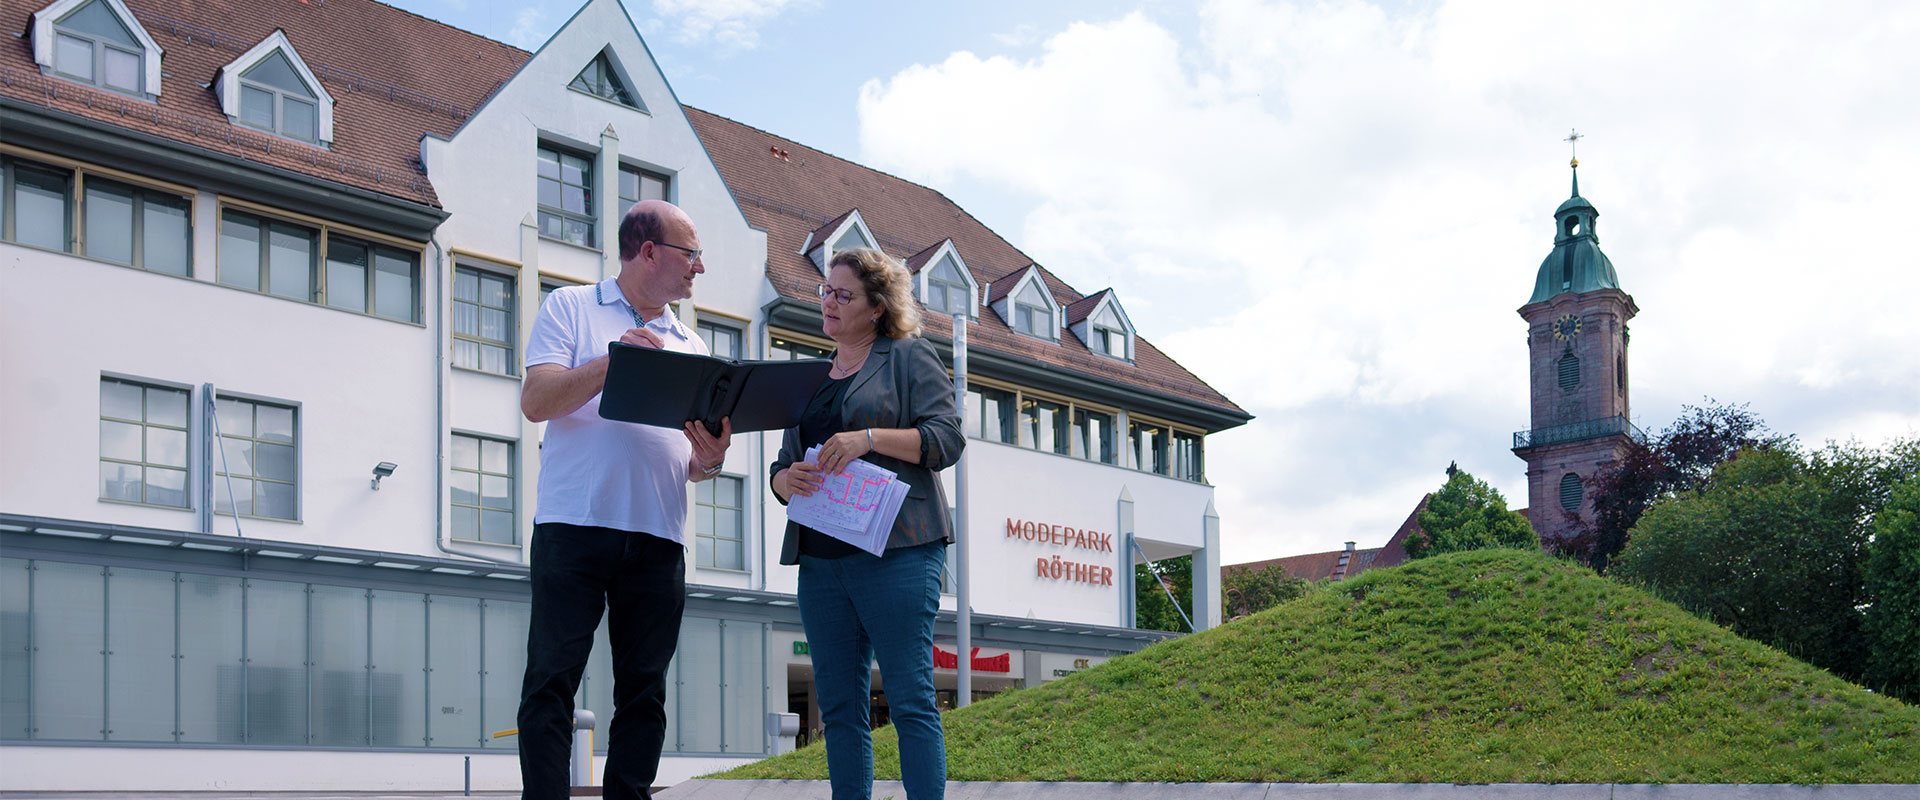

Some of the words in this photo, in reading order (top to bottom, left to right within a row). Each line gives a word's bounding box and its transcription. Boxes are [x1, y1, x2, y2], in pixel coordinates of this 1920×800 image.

[1006, 517, 1112, 553] MODEPARK
[1037, 555, 1113, 587] RÖTHER
[933, 645, 958, 669] NE
